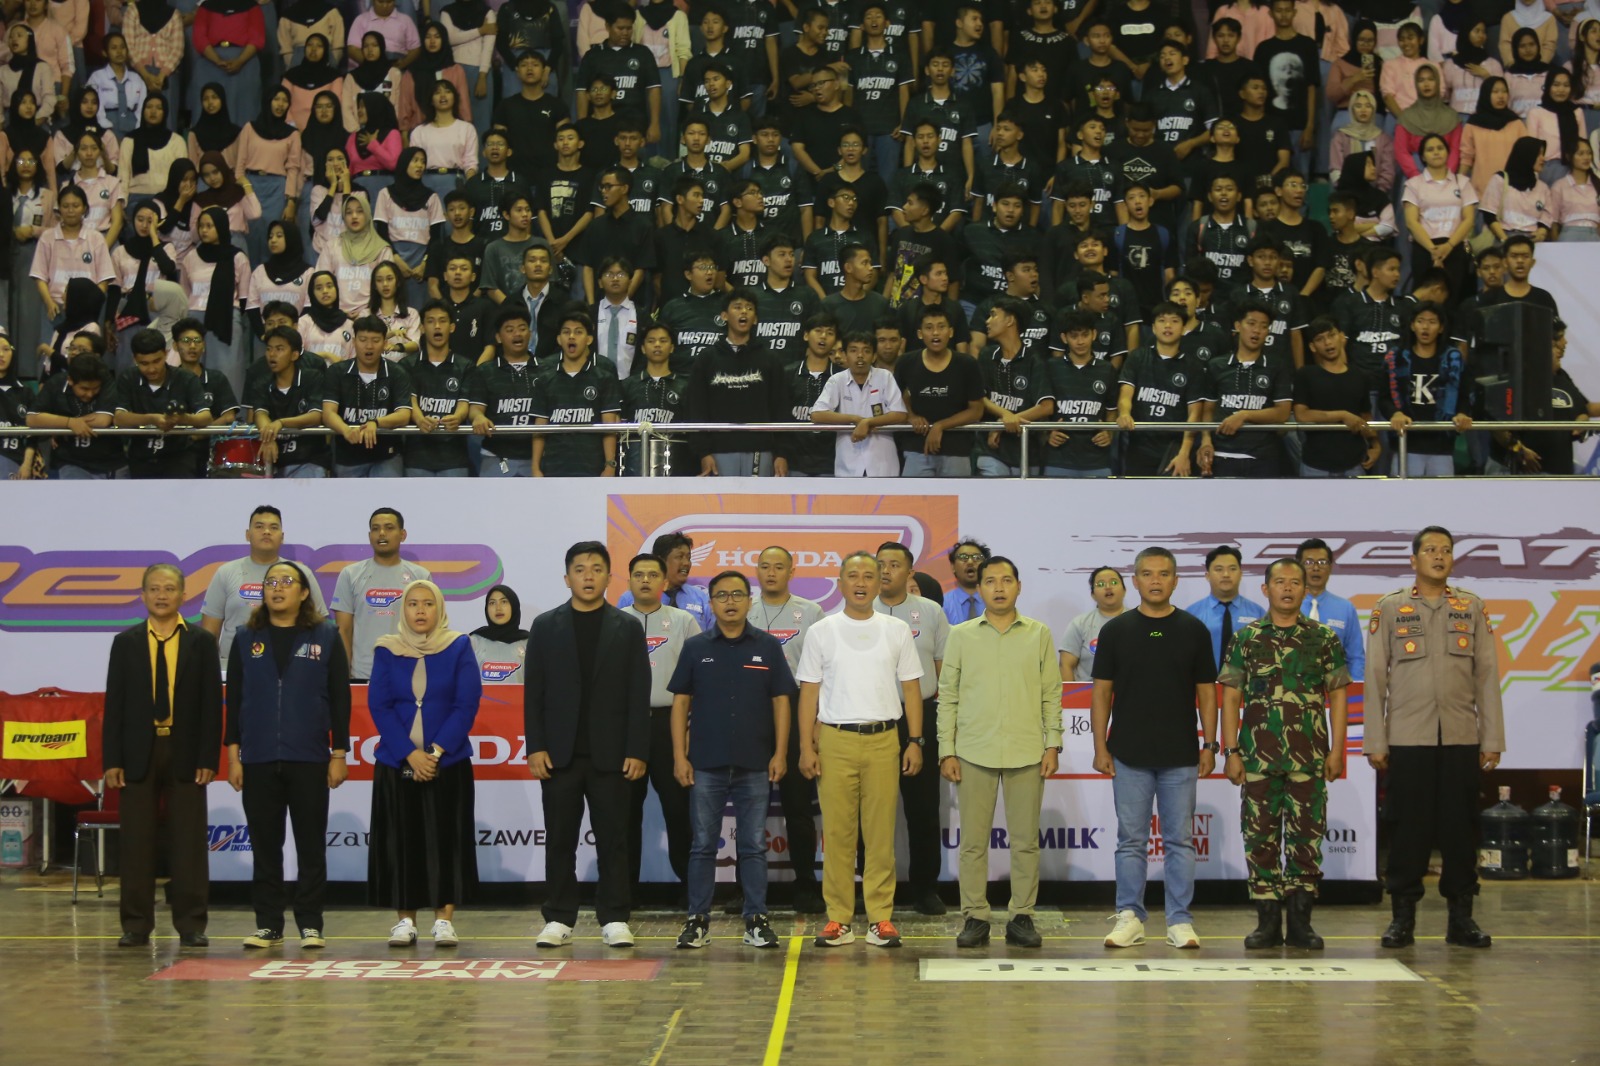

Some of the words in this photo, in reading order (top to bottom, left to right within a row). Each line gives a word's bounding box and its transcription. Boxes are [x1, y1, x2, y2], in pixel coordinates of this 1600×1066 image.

[744, 39, 757, 48] 19
[826, 42, 840, 51] 19
[857, 77, 895, 90] MASTRIP
[866, 90, 881, 100] 19
[1163, 131, 1179, 141] 19
[708, 154, 722, 163] 19
[490, 220, 503, 231] 19
[742, 275, 758, 286] 19
[757, 322, 801, 337] MASTRIP
[770, 338, 787, 350] 19
[1371, 343, 1387, 353] 19
[1137, 387, 1181, 407] MASTRIP
[1150, 404, 1166, 417] 19
[511, 415, 529, 426] 19
[2, 437, 19, 450] 19
[282, 440, 297, 454] 19
[1396, 615, 1421, 623] AGUNG
[1448, 612, 1472, 620] POLRI
[11, 731, 78, 745] proteam
[1039, 828, 1099, 849] MILK
[1328, 846, 1357, 854] SHOES
[256, 960, 470, 971] HOT
[249, 969, 558, 979] CREAM
